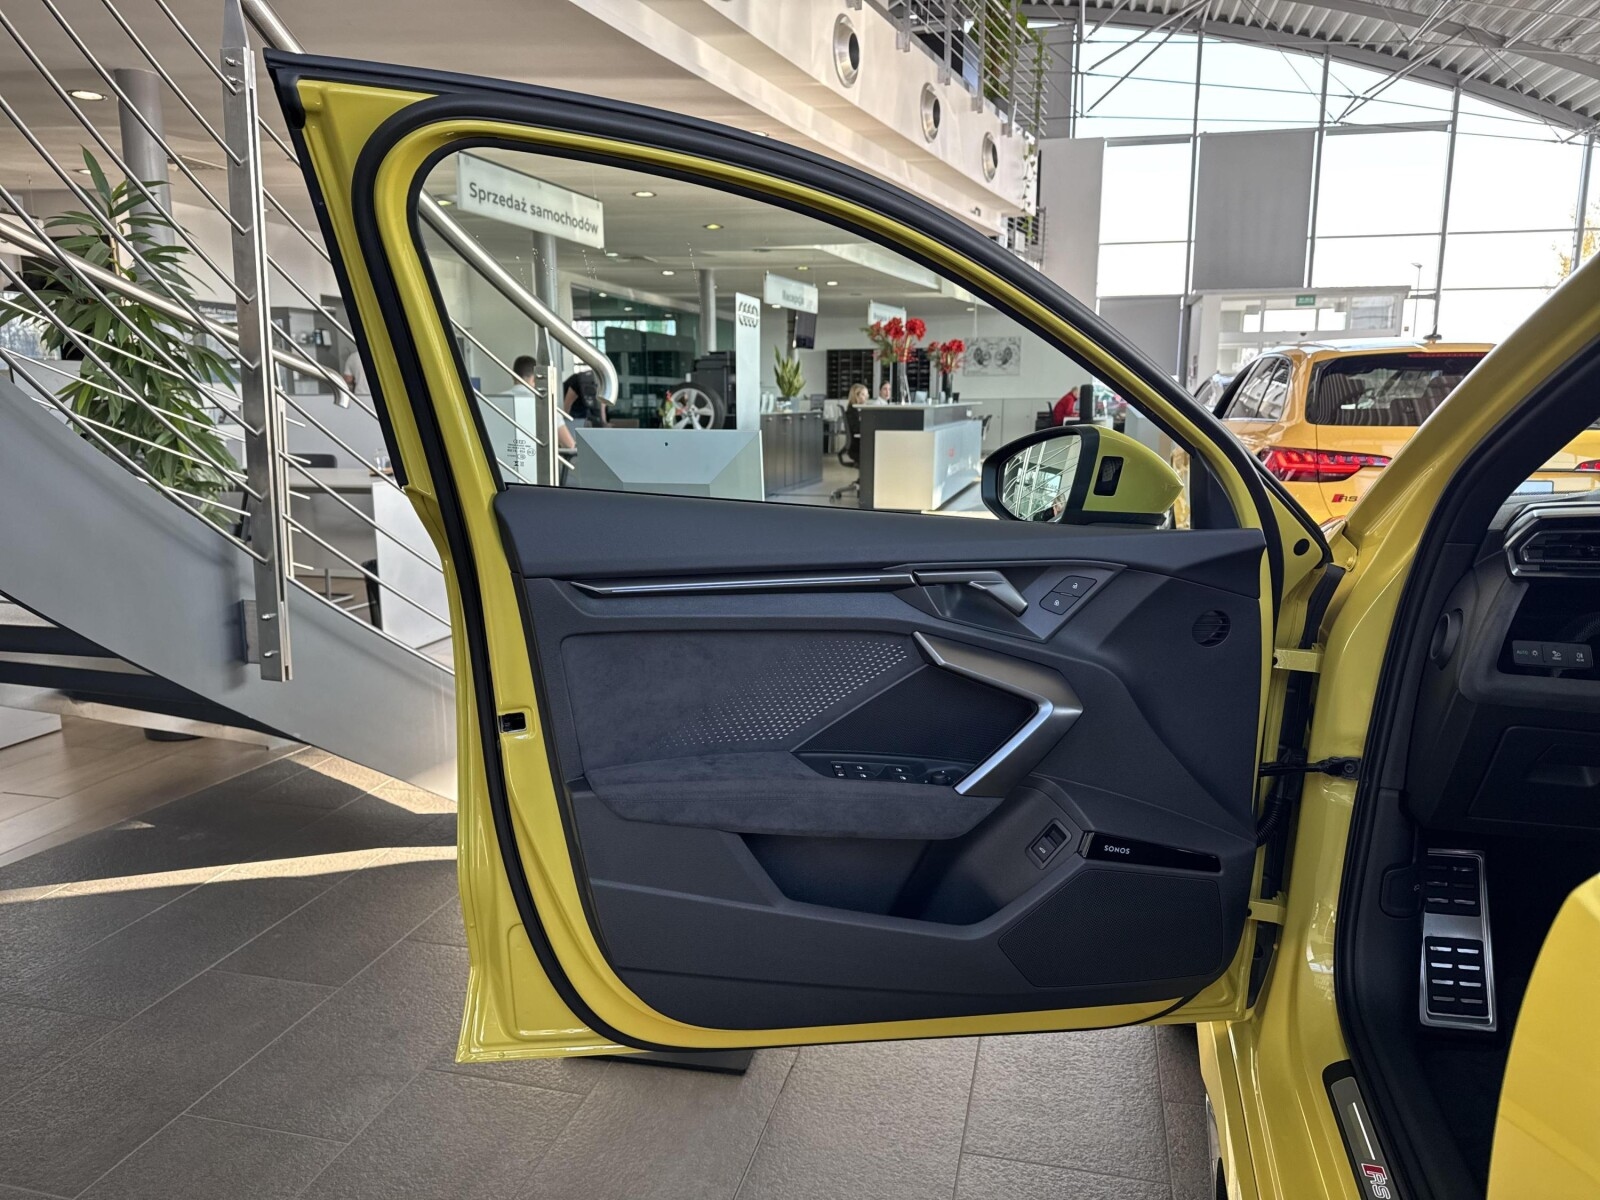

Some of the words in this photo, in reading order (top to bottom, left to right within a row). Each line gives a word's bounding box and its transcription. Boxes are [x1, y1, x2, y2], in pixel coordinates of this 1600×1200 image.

[469, 182, 528, 214] Sprzedaż
[530, 203, 599, 235] samochodów
[1332, 494, 1358, 503] RS
[1104, 844, 1131, 855] SONOS
[1361, 1163, 1391, 1200] RS
